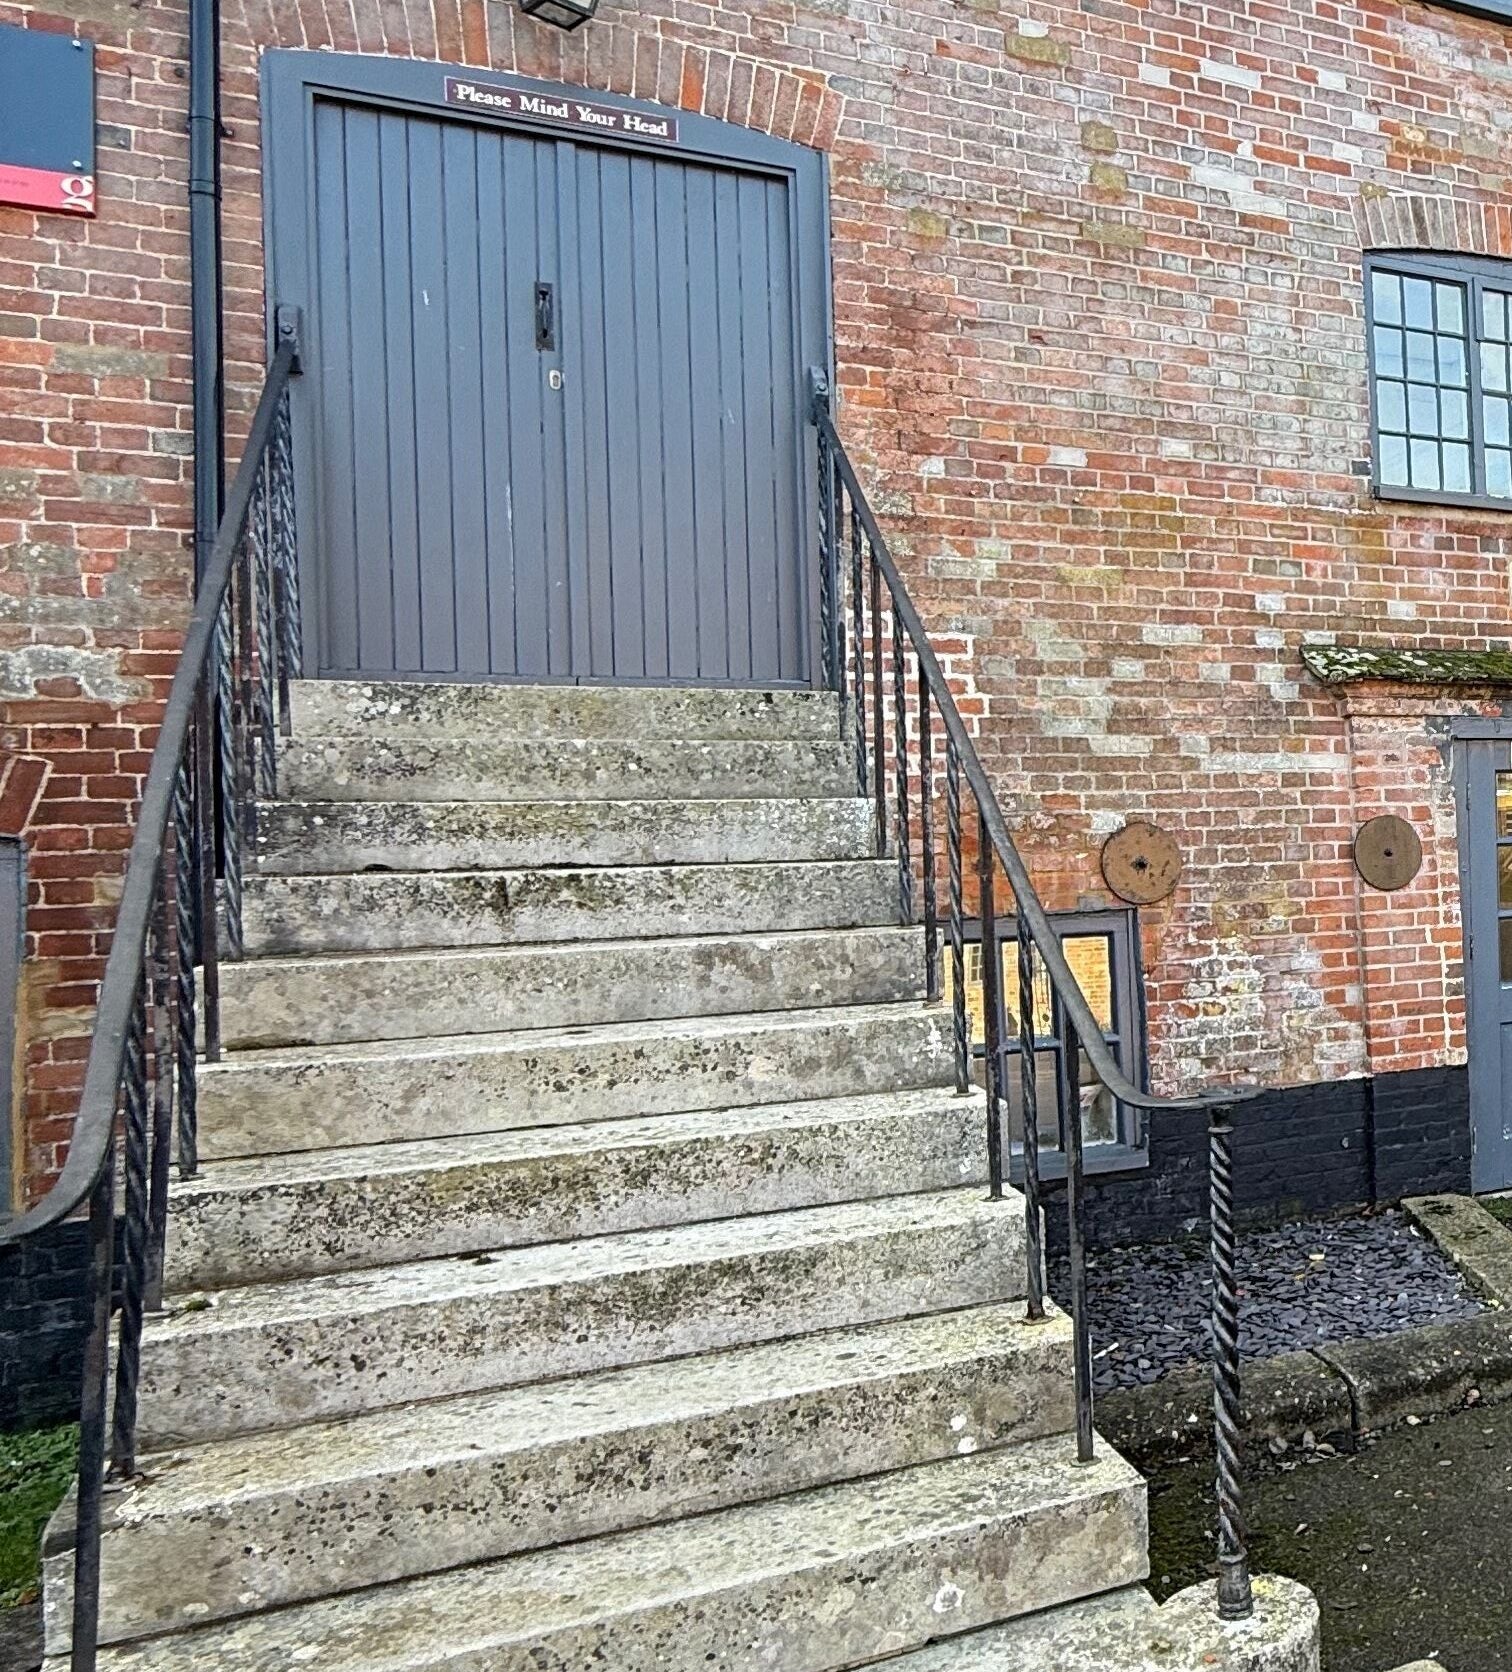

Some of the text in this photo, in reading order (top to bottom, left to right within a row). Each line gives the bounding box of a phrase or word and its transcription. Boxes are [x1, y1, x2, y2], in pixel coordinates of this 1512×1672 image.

[456, 84, 668, 136] Please Mind Your Head
